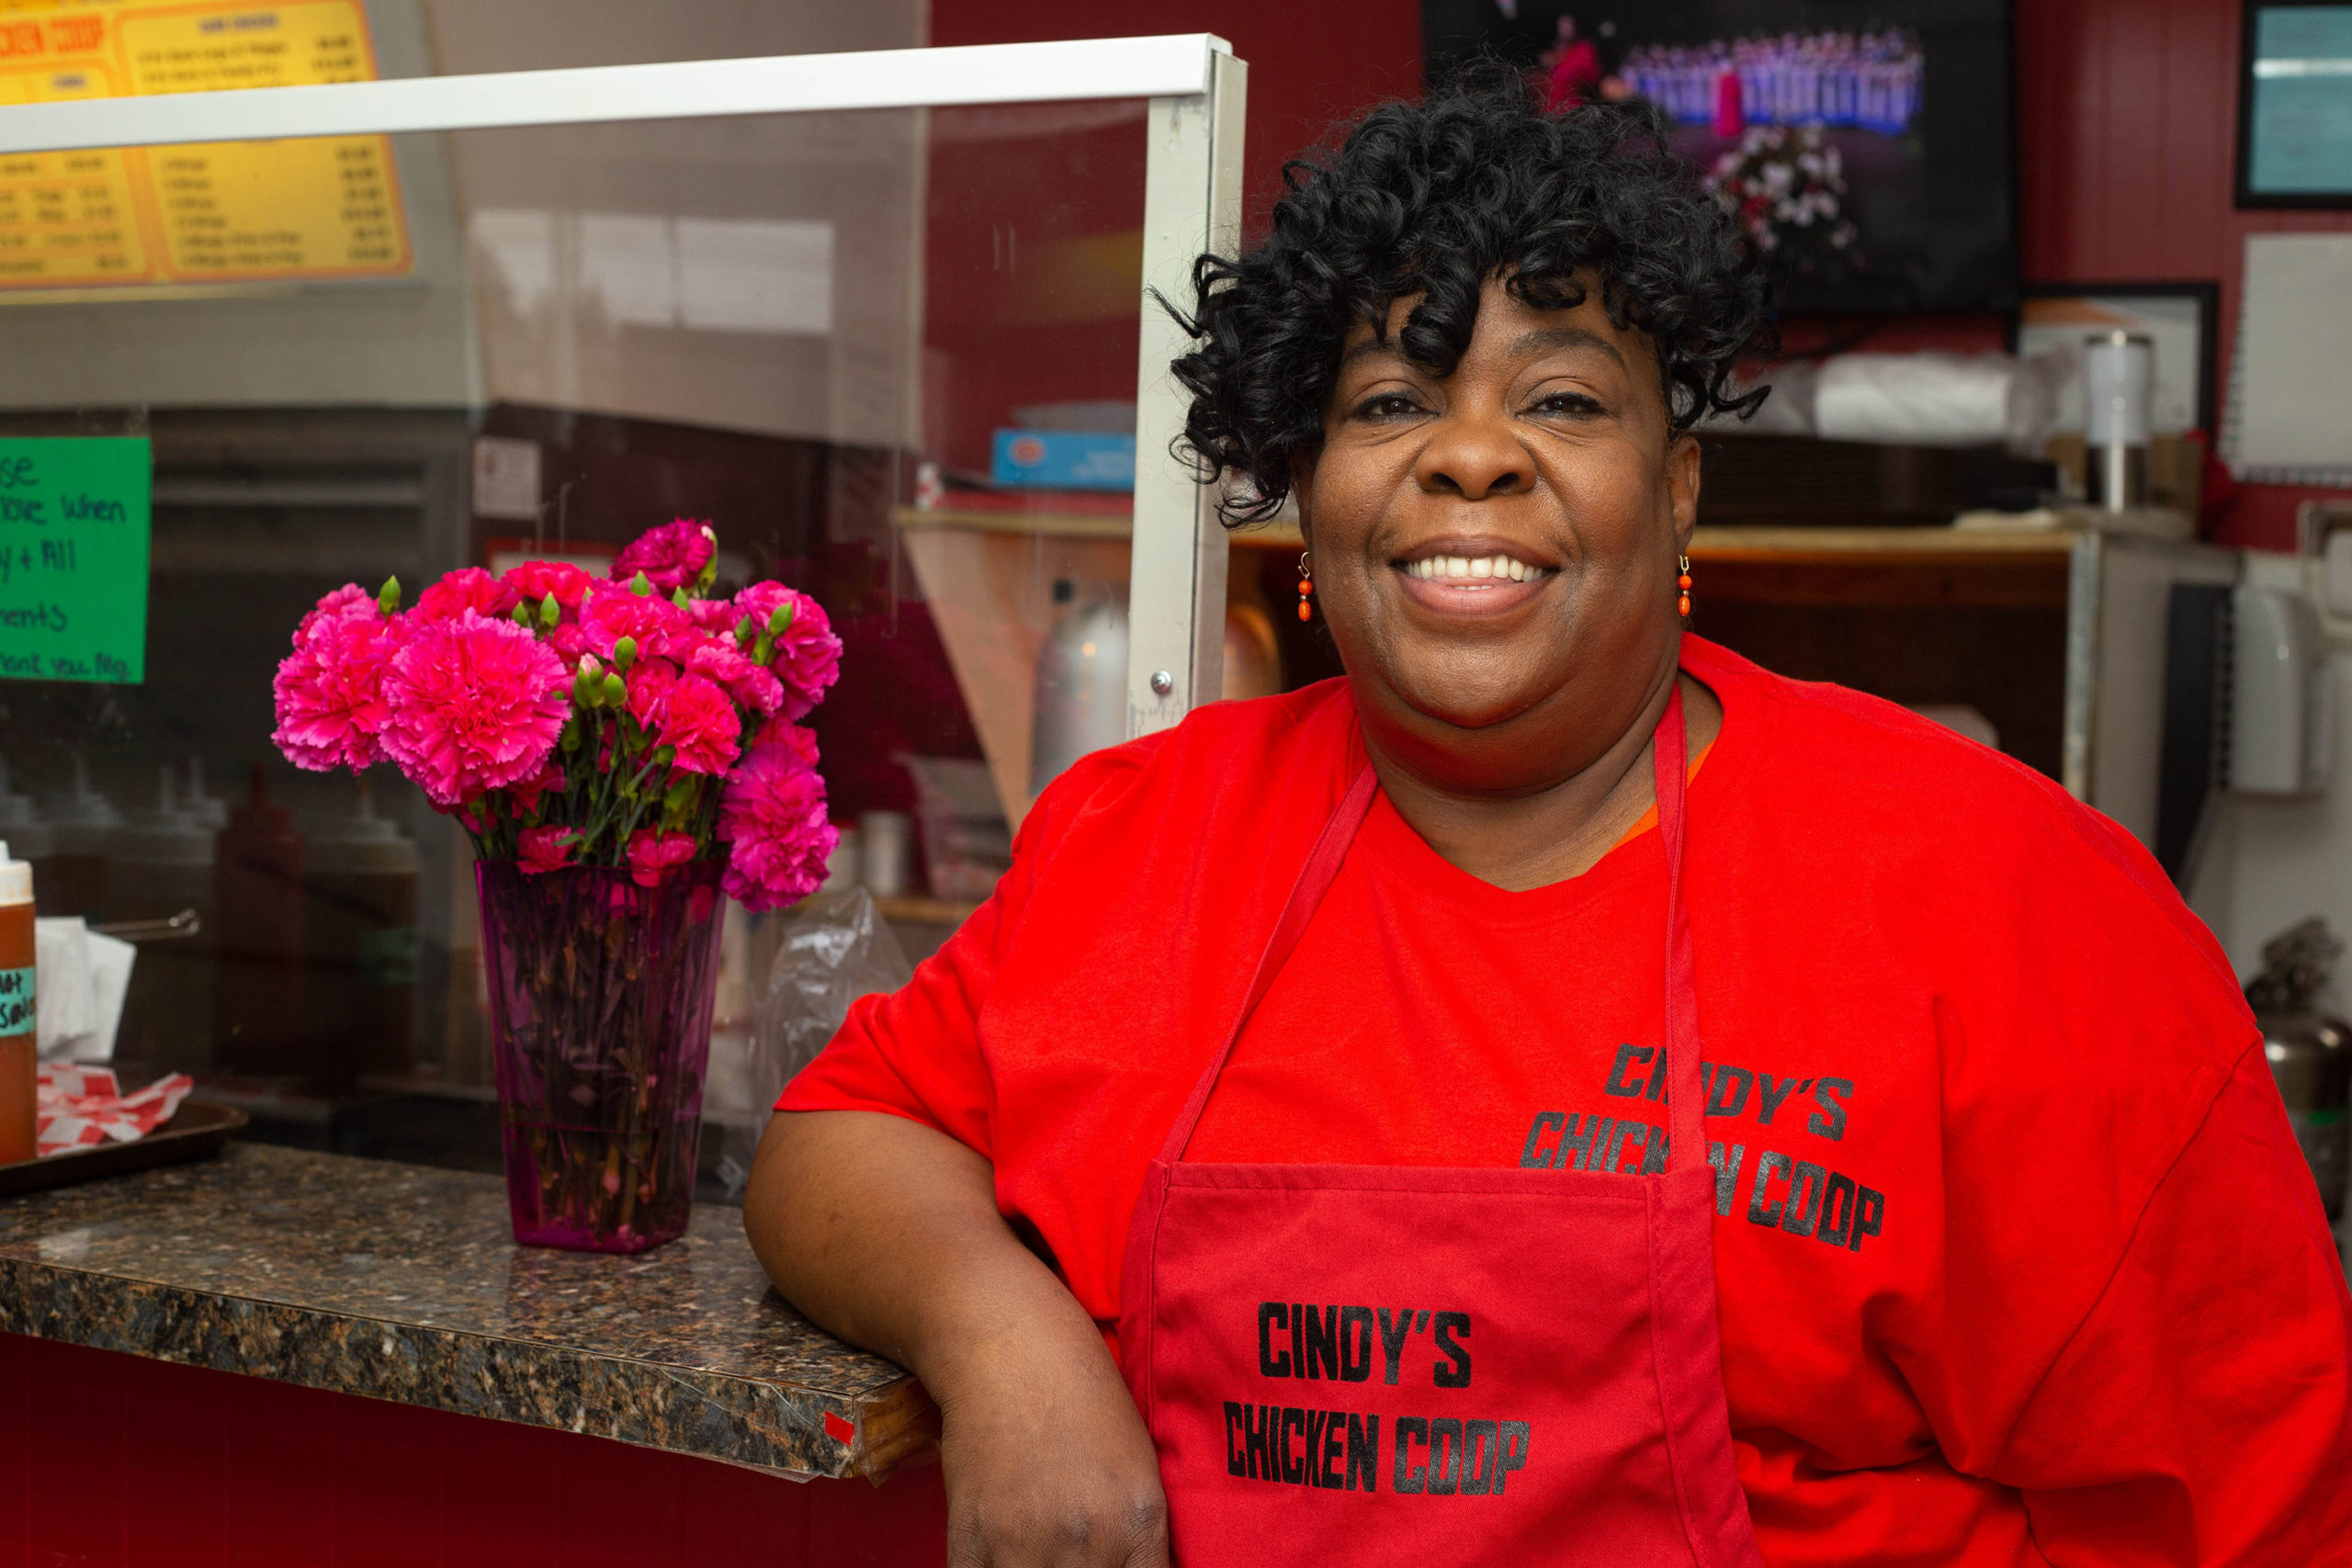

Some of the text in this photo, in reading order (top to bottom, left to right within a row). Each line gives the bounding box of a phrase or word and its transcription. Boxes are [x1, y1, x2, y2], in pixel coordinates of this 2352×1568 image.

[1519, 1111, 1885, 1252] CHICKN COOP
[1258, 1302, 1471, 1388] CINDY'S
[1224, 1401, 1531, 1496] CHICKEN COOP
